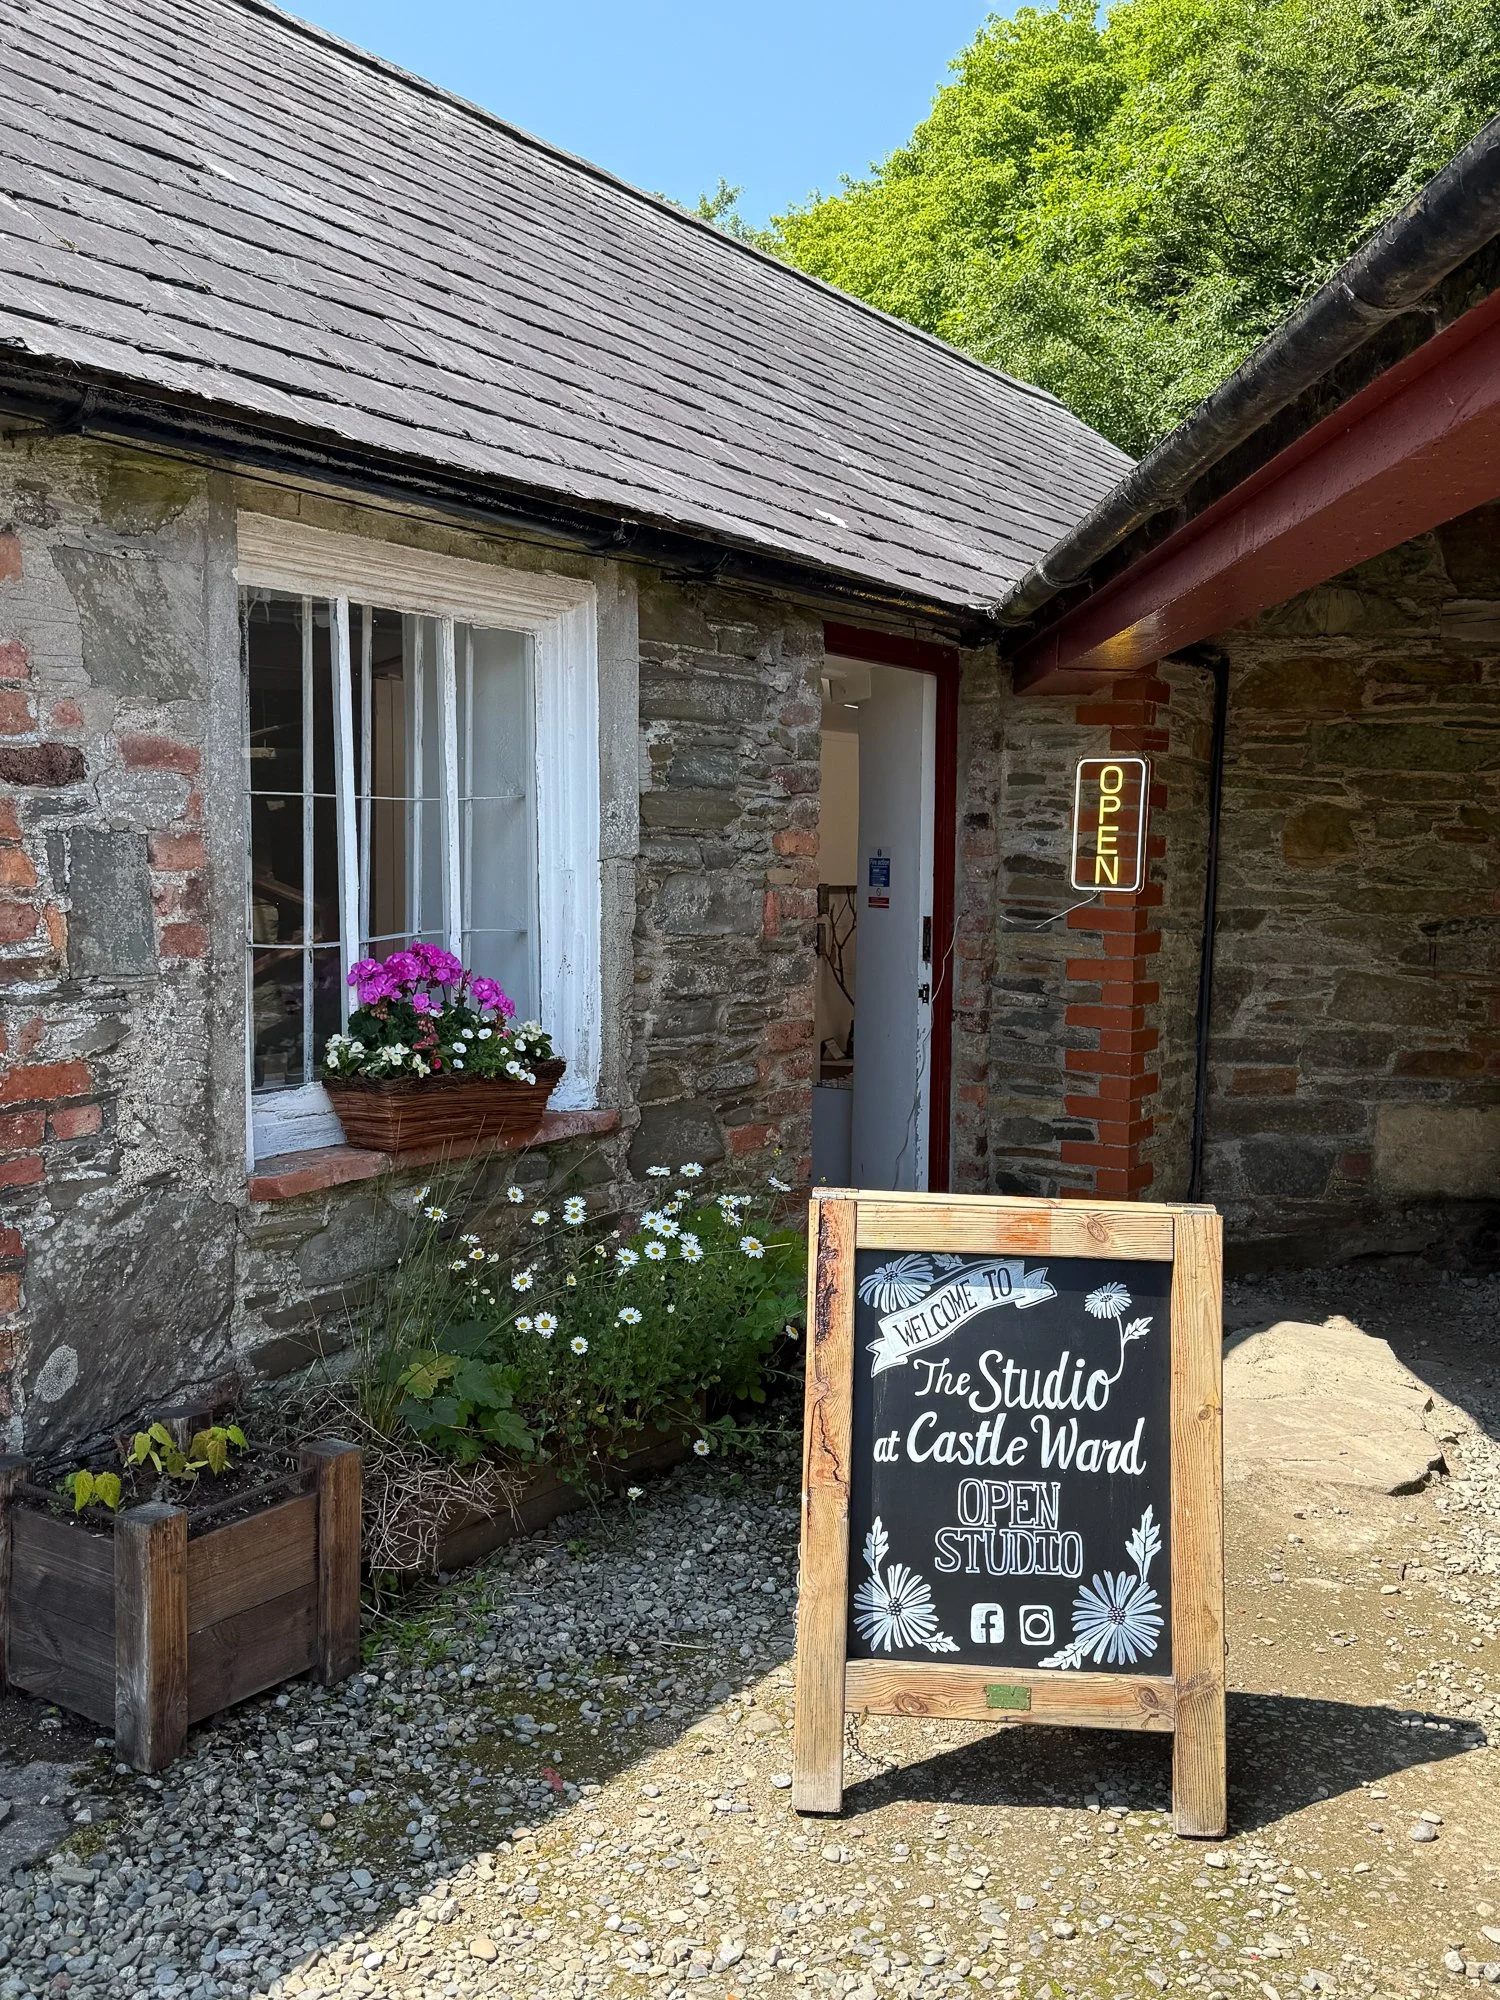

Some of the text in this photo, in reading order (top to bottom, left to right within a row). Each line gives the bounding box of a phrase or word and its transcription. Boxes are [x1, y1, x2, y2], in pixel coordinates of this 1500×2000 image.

[1094, 765, 1124, 885] OPEN
[892, 1267, 1013, 1348] WELCOME TO
[913, 1349, 1110, 1414] The Studio
[872, 1410, 1147, 1476] at Castle Ward
[957, 1477, 1061, 1530] OPEN
[934, 1526, 1084, 1579] STUDIO
